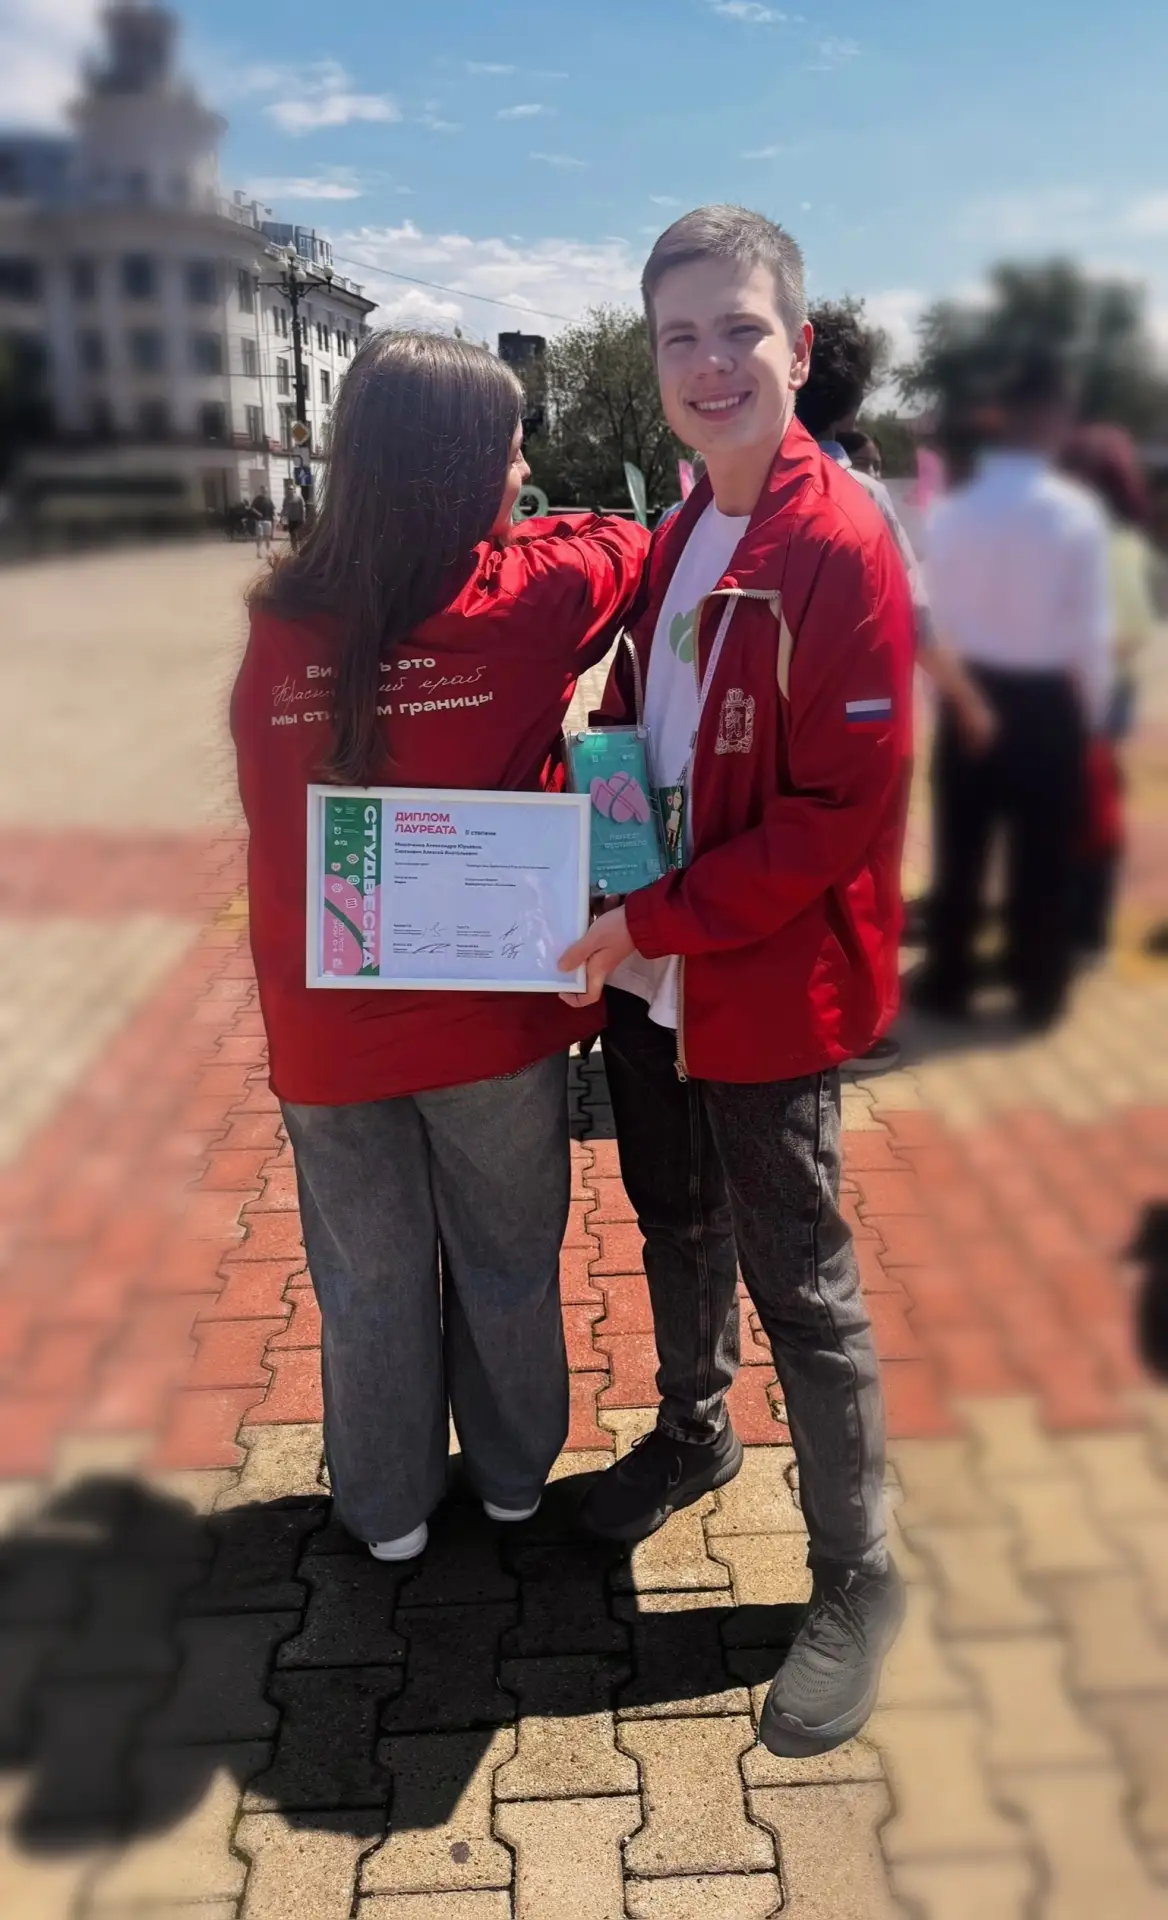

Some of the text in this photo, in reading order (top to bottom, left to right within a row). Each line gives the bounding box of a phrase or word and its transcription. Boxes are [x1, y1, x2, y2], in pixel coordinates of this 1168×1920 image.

[397, 657, 436, 671] это
[418, 665, 487, 694] край
[271, 714, 298, 726] мы
[399, 691, 494, 716] границы
[394, 811, 450, 822] ДИПЛОМ
[394, 823, 457, 835] ЛАУРЕАТА
[363, 805, 378, 968] СТУДВЕСНА
